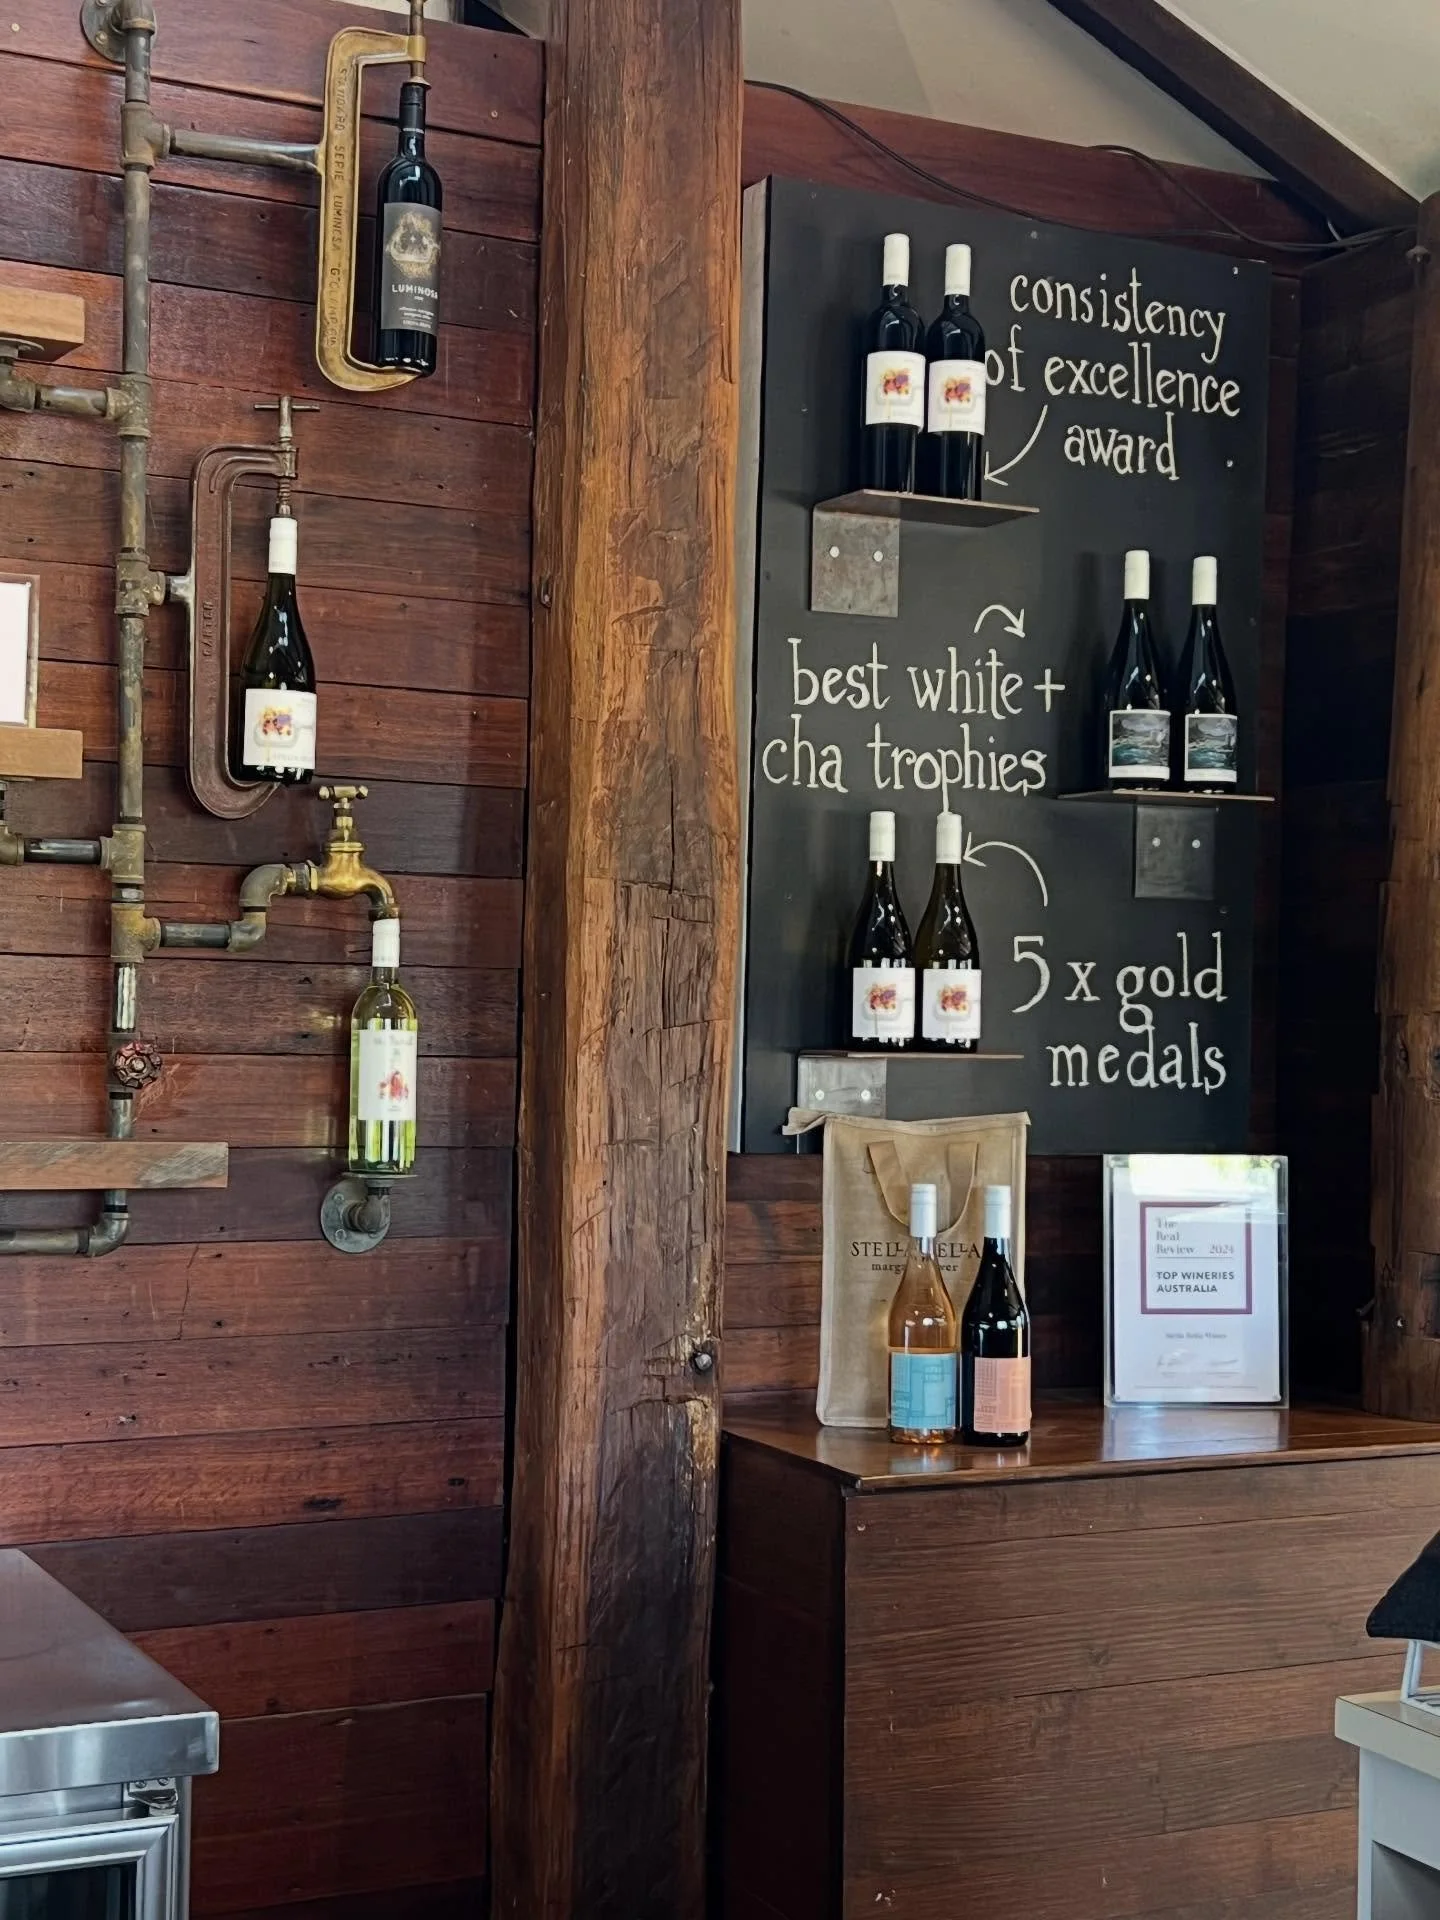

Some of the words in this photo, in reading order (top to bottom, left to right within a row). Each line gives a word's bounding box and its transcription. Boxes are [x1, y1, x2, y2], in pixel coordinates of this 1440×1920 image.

[1010, 267, 1226, 364] consistency
[984, 324, 1027, 391] of
[1044, 342, 1241, 416] excellence
[1064, 411, 1179, 481] award
[787, 637, 891, 710] best
[906, 646, 1023, 720] white
[1033, 668, 1066, 712] +
[762, 713, 849, 793] cha
[866, 722, 1047, 813] trophies
[1012, 935, 1050, 1013] 5
[1064, 961, 1101, 1002] x
[1116, 931, 1228, 1034] gold
[1046, 1022, 1227, 1095] medals
[937, 1241, 982, 1259] ELLA
[1155, 1217, 1179, 1229] The
[1156, 1231, 1180, 1241] Real
[1156, 1243, 1196, 1254] Review
[1156, 1271, 1178, 1280] TOP
[1181, 1271, 1235, 1280] WINERIES
[1156, 1284, 1218, 1293] AUSTRALIA
